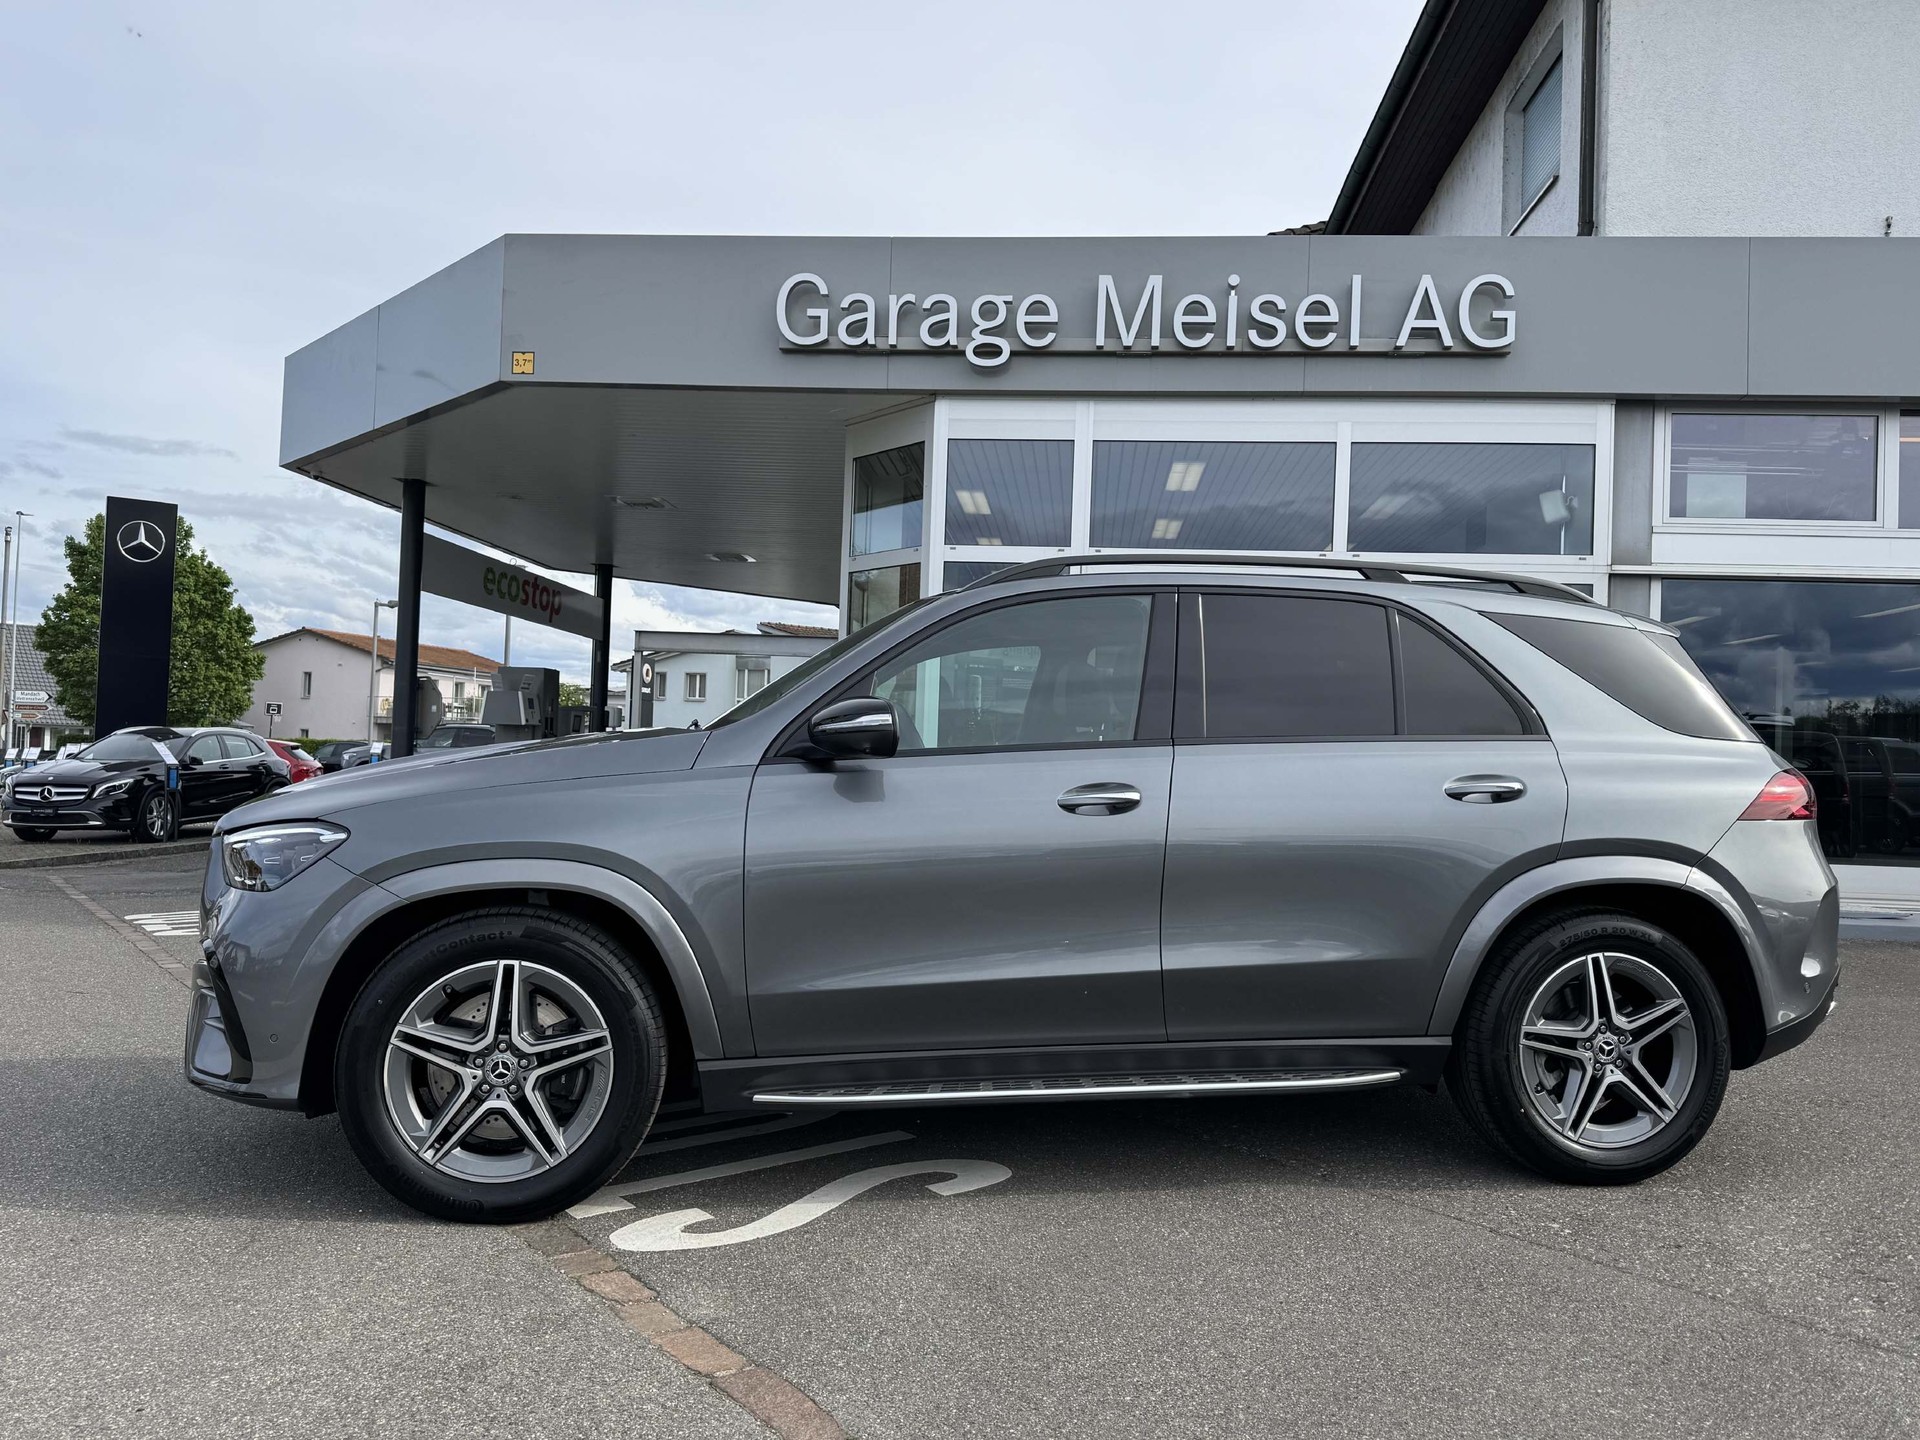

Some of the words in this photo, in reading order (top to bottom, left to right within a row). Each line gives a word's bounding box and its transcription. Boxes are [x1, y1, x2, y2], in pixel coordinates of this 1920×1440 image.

[776, 271, 1060, 368] Garage
[1094, 273, 1361, 350] Meisel
[1396, 273, 1518, 350] AG
[483, 566, 562, 623] ecostop
[1558, 928, 1598, 949] 275/50
[1600, 926, 1609, 935] R
[1611, 926, 1627, 935] 20
